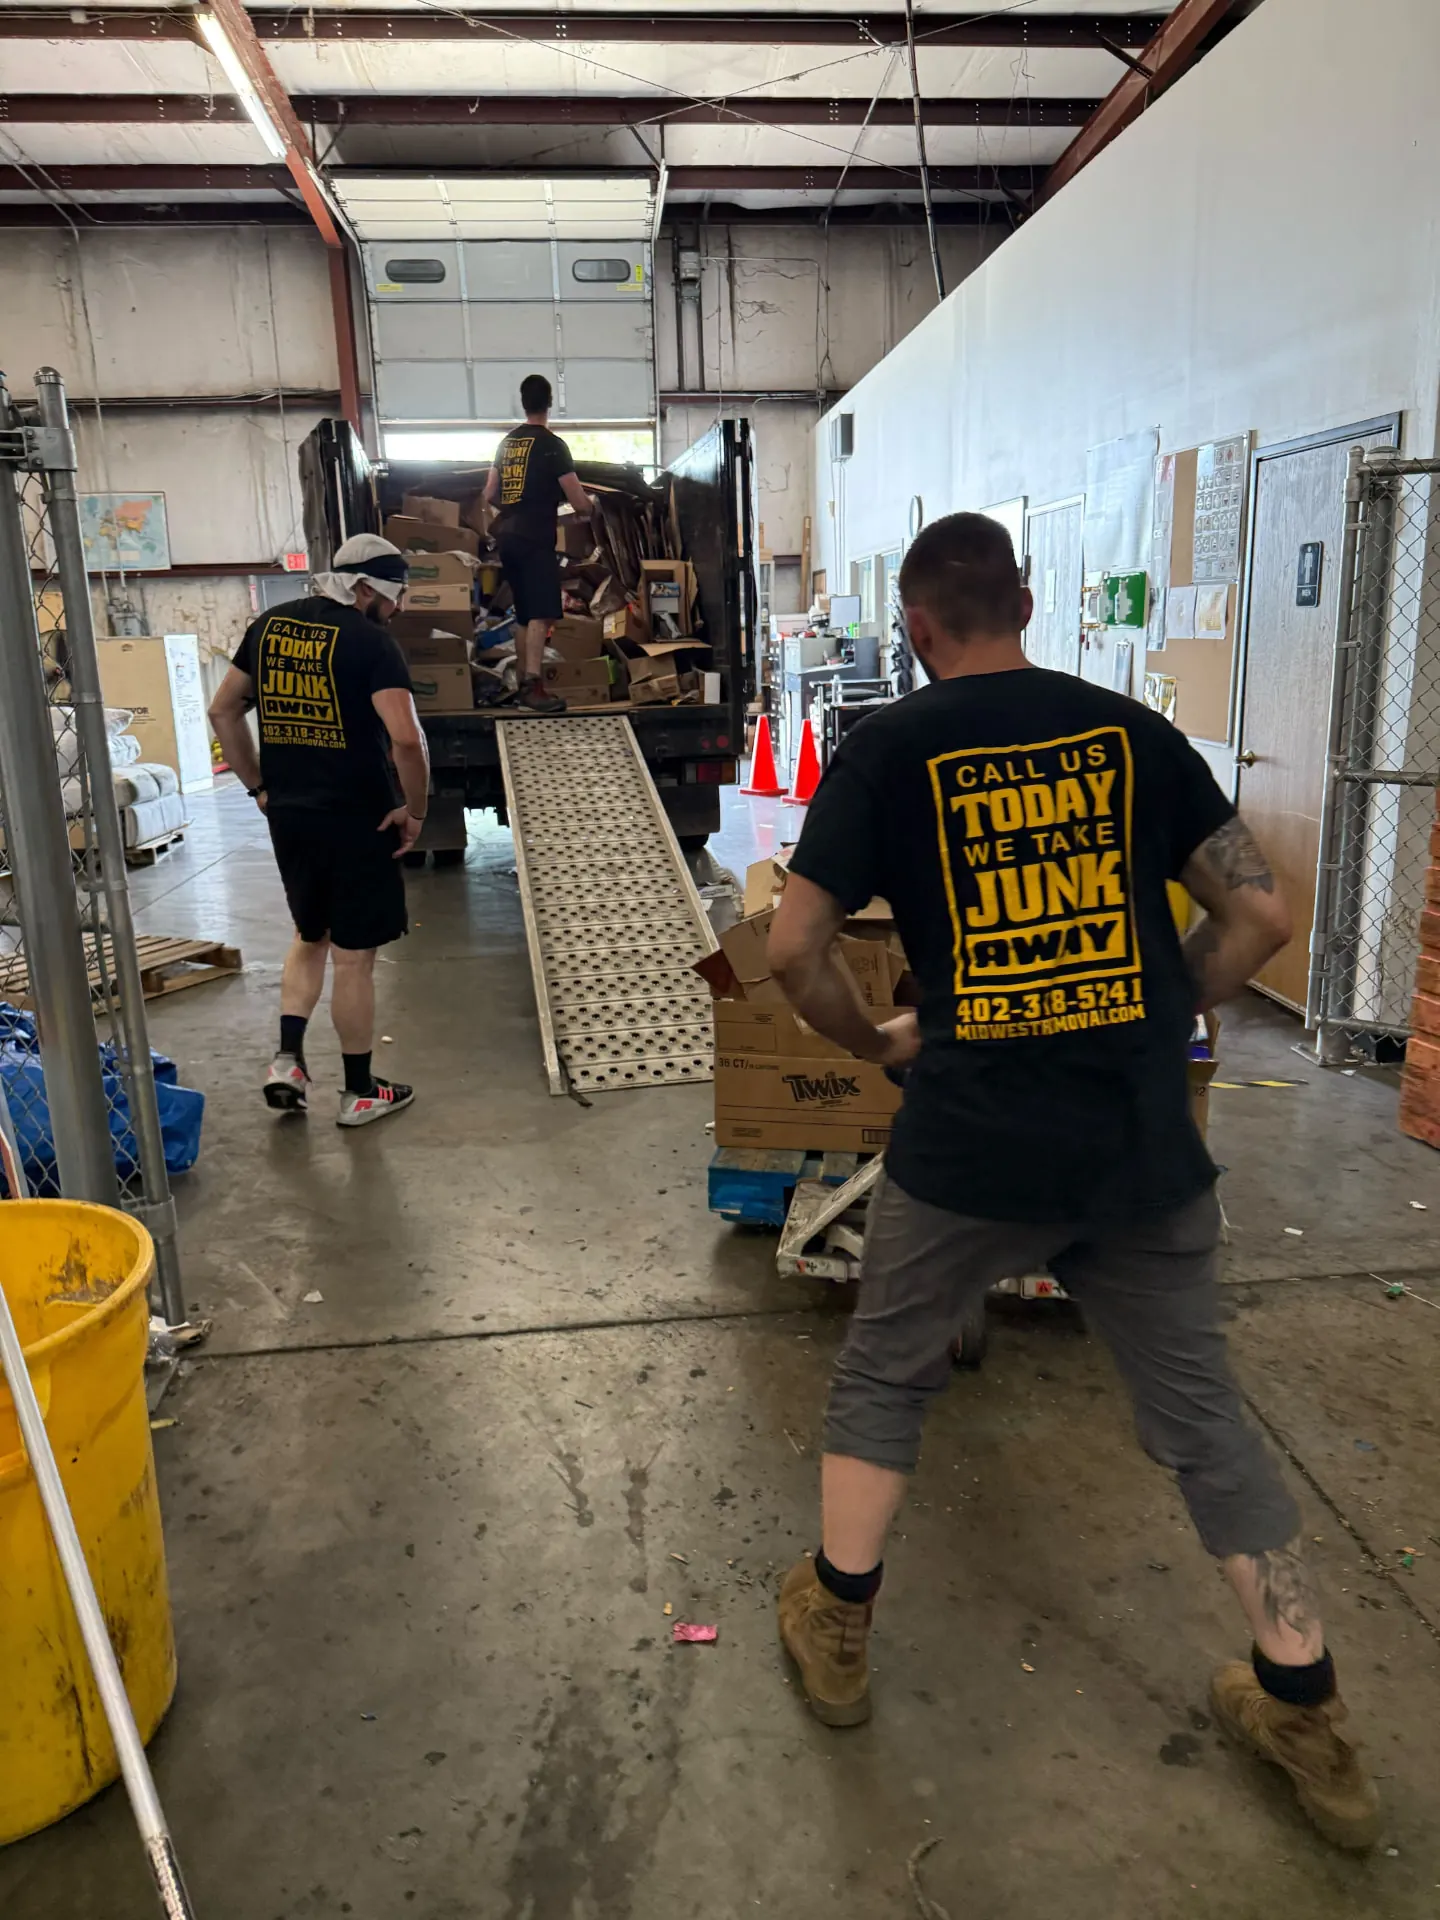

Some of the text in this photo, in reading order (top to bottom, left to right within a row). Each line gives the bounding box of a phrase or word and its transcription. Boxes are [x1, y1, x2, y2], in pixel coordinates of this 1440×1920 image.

[266, 633, 327, 660] TODAY
[272, 623, 328, 640] CALL US
[265, 656, 323, 673] WE TAKE
[262, 669, 331, 700] JUNK
[266, 700, 331, 719] AWAY
[956, 743, 1107, 788] CALL US
[950, 769, 1117, 839] TODAY
[963, 822, 1116, 867] WE TAKE
[965, 850, 1126, 928] JUNK
[973, 919, 1119, 969] AWAY
[955, 1003, 1147, 1041] MIDWESTRMOVAL.COM
